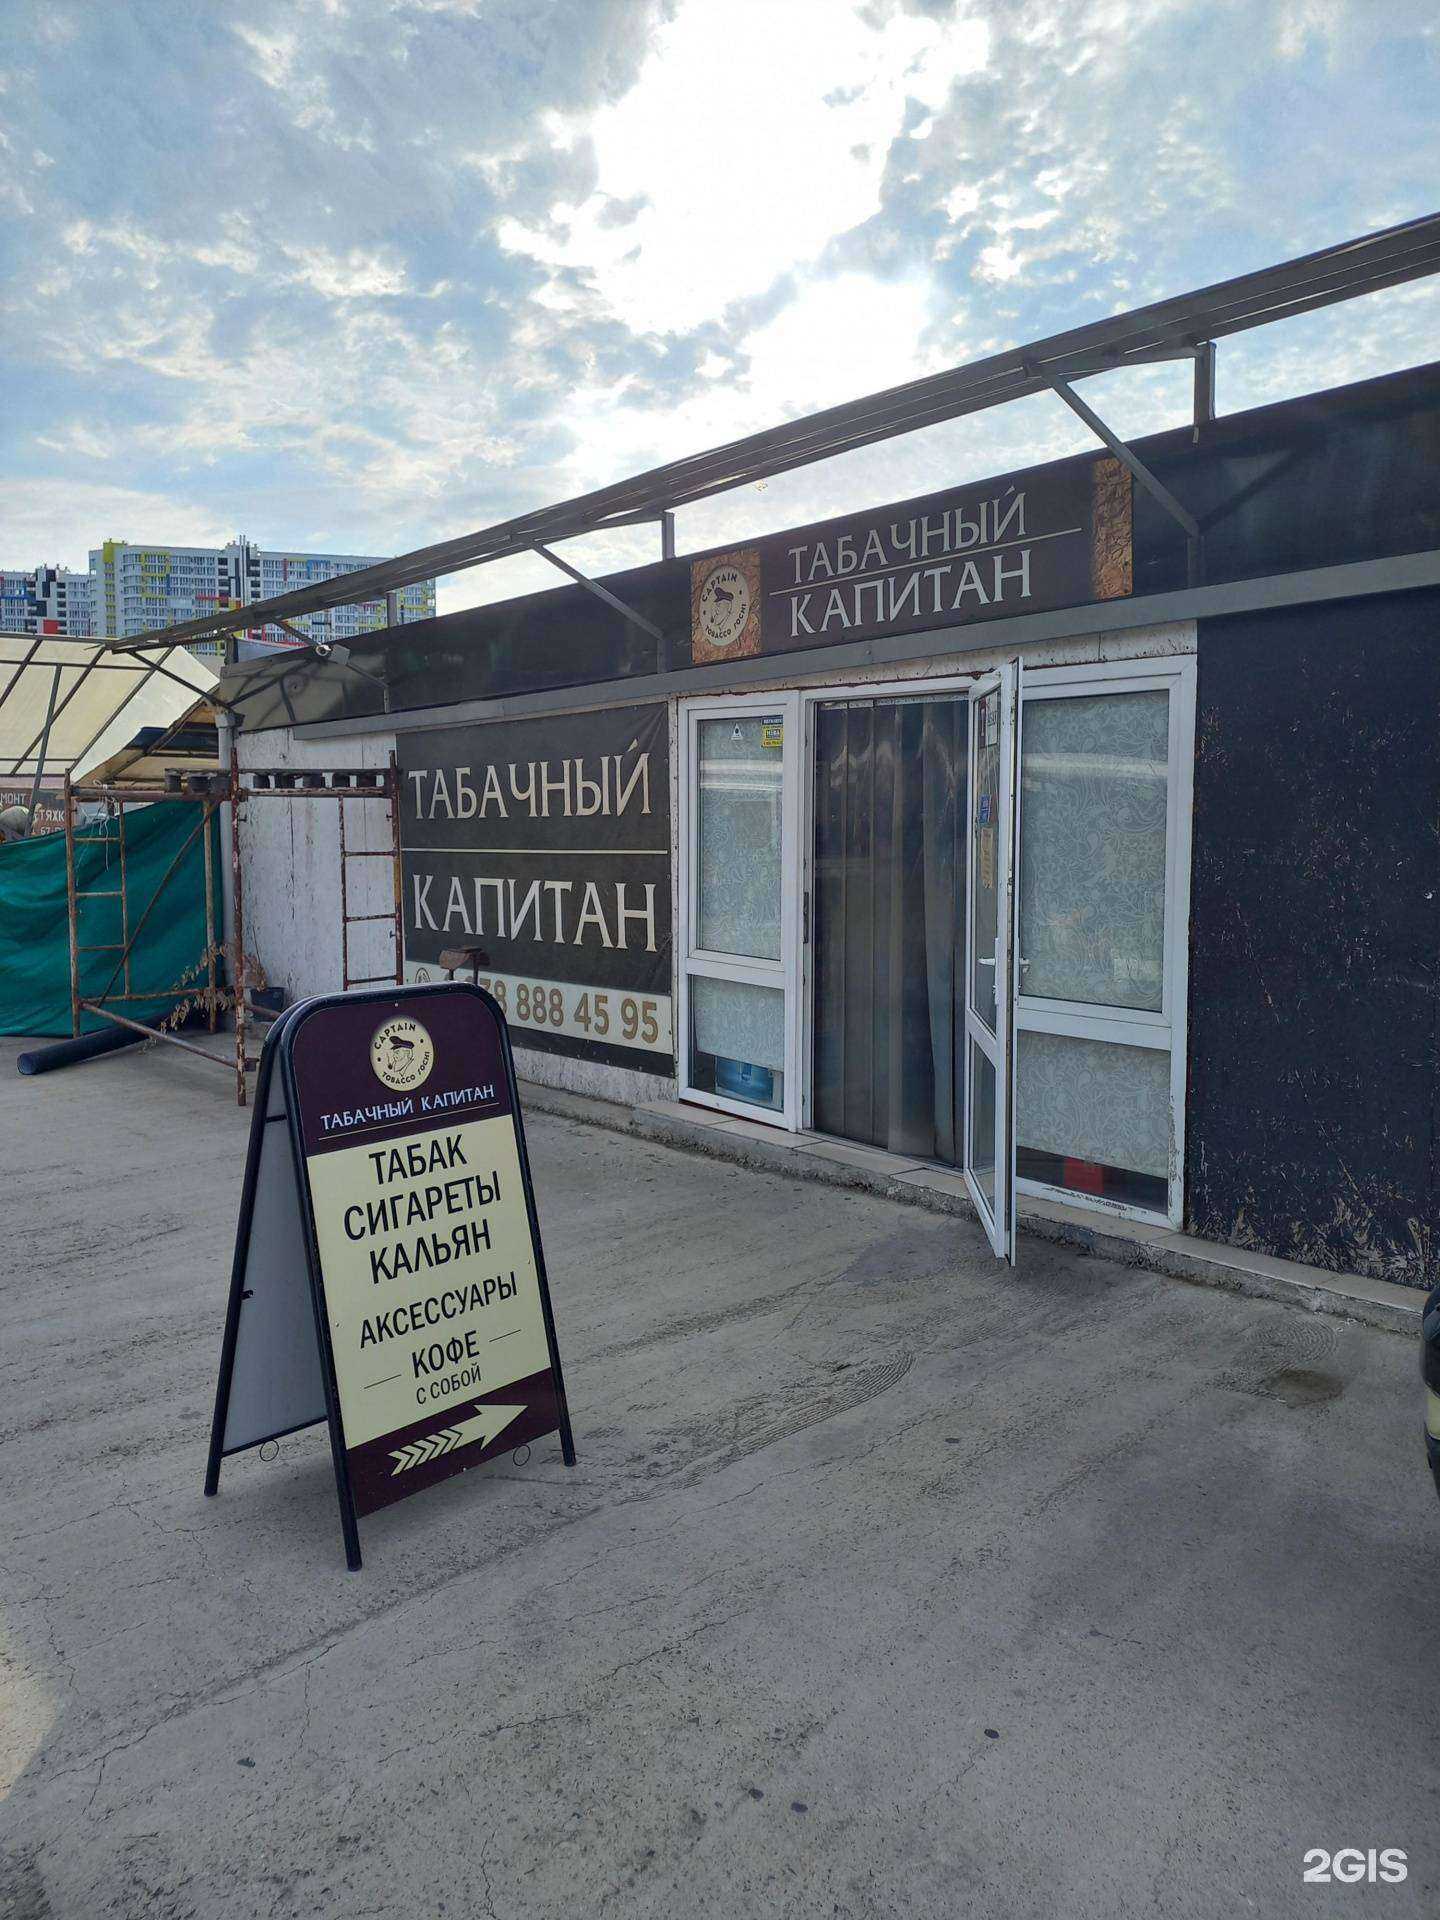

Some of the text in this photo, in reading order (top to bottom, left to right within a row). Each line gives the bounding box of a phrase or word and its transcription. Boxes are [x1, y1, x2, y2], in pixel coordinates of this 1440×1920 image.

[788, 485, 1027, 584] ТАБАЧНЫЙ
[702, 573, 737, 602] CAPTAIN
[790, 549, 1032, 637] КАПИТАН
[705, 625, 732, 639] TOBACCO
[408, 738, 652, 820] ТАБАЧНЫЙ
[412, 874, 658, 952] КАПИТАН
[374, 1023, 416, 1050] CAPTAIN
[516, 983, 565, 1028] 888
[573, 992, 610, 1035] 45
[620, 998, 659, 1044] 95
[382, 1071, 416, 1085] TOBACCO
[320, 1084, 495, 1131] ТАБАЧНЫЙ КАПИТАН
[368, 1134, 468, 1185] ТАБАК
[344, 1170, 502, 1241] СИГАРЕТЫ
[369, 1218, 492, 1284] КАЛЬЯН
[360, 1271, 518, 1349] АКСЕССУАРЫ
[411, 1330, 480, 1378] КОФЕ
[416, 1363, 482, 1405] С СОБОЙ
